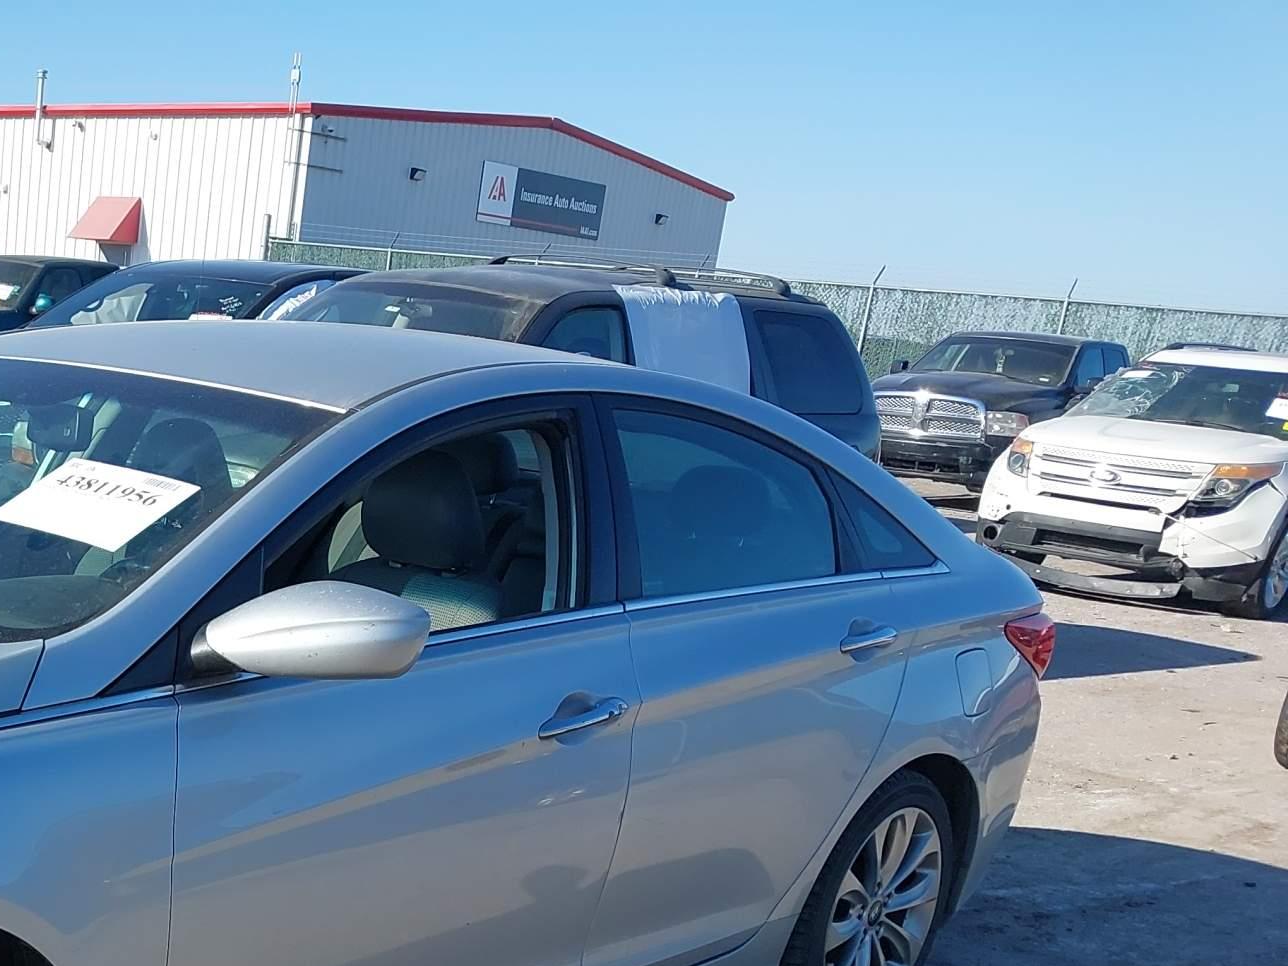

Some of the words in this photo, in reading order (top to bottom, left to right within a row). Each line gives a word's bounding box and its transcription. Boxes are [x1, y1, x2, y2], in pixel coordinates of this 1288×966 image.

[520, 187, 553, 206] Insurance
[554, 194, 569, 209] Auto
[569, 197, 598, 214] Auctions
[57, 474, 162, 506] 43811956
